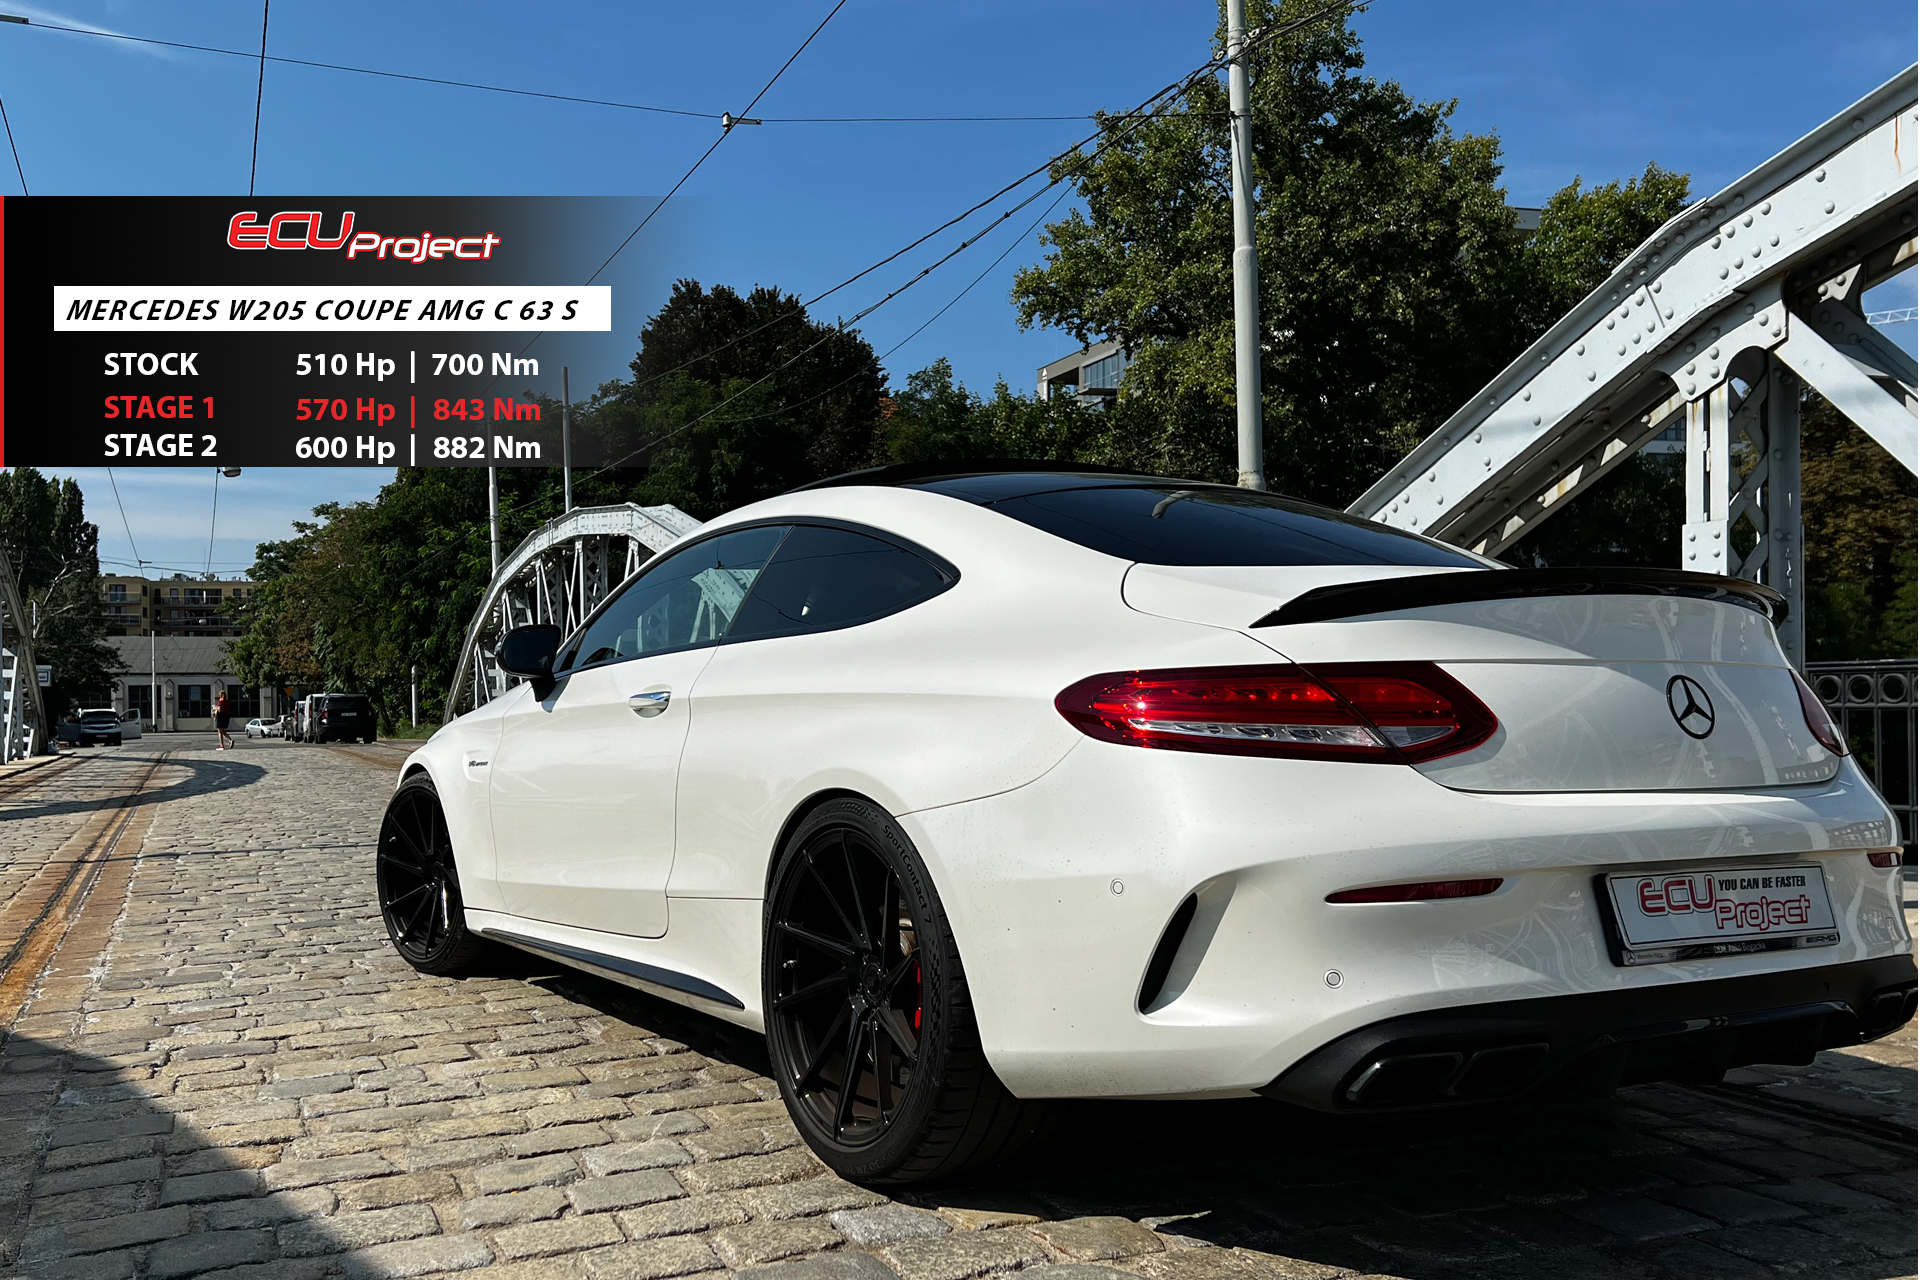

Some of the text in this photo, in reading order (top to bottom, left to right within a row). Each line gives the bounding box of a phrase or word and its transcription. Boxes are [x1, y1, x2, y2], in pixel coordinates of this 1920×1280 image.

[882, 825, 932, 924] SportContact 7
[1718, 875, 1806, 891] YOU CAN BE FASTER
[1637, 874, 1716, 917] ECU
[1715, 894, 1811, 931] Project
